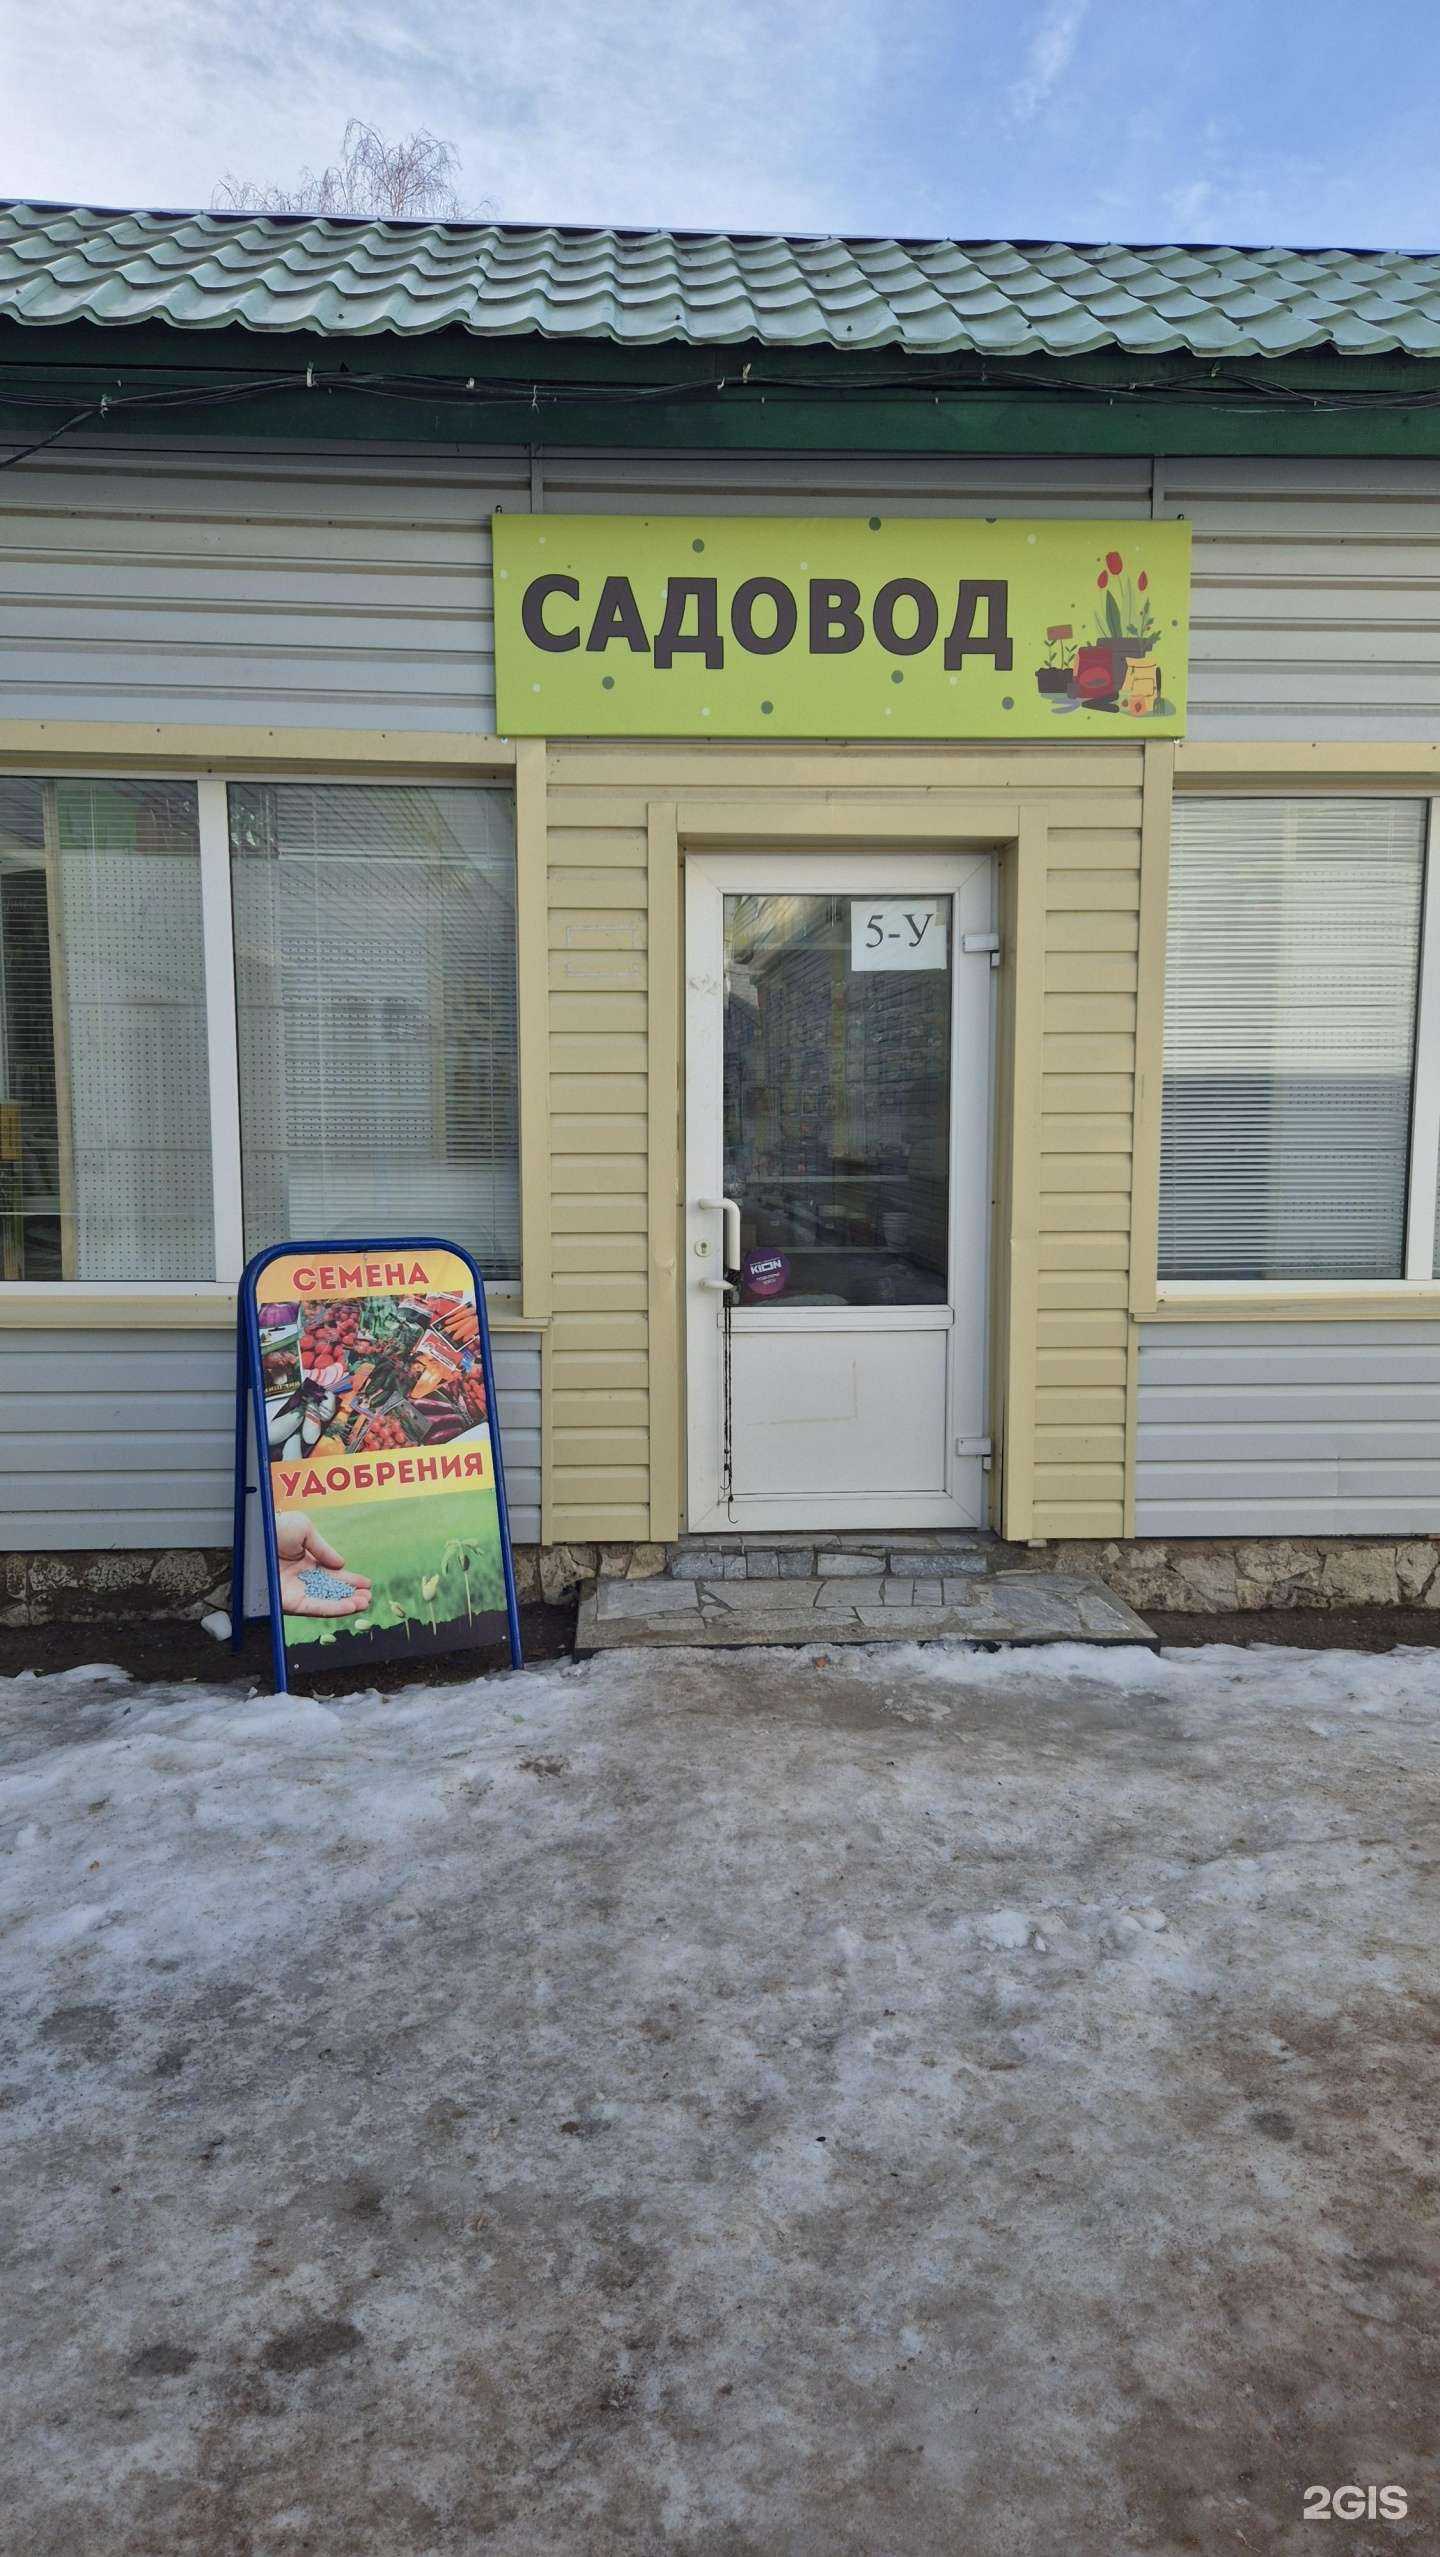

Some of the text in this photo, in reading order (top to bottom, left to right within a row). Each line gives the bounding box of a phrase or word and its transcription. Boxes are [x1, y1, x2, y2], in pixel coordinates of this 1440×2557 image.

[522, 574, 1013, 670] САДОВОД
[865, 914, 934, 948] 5-У
[292, 1262, 430, 1291] СЕМЕНА
[279, 1452, 484, 1498] УДОБРЕНИЯ
